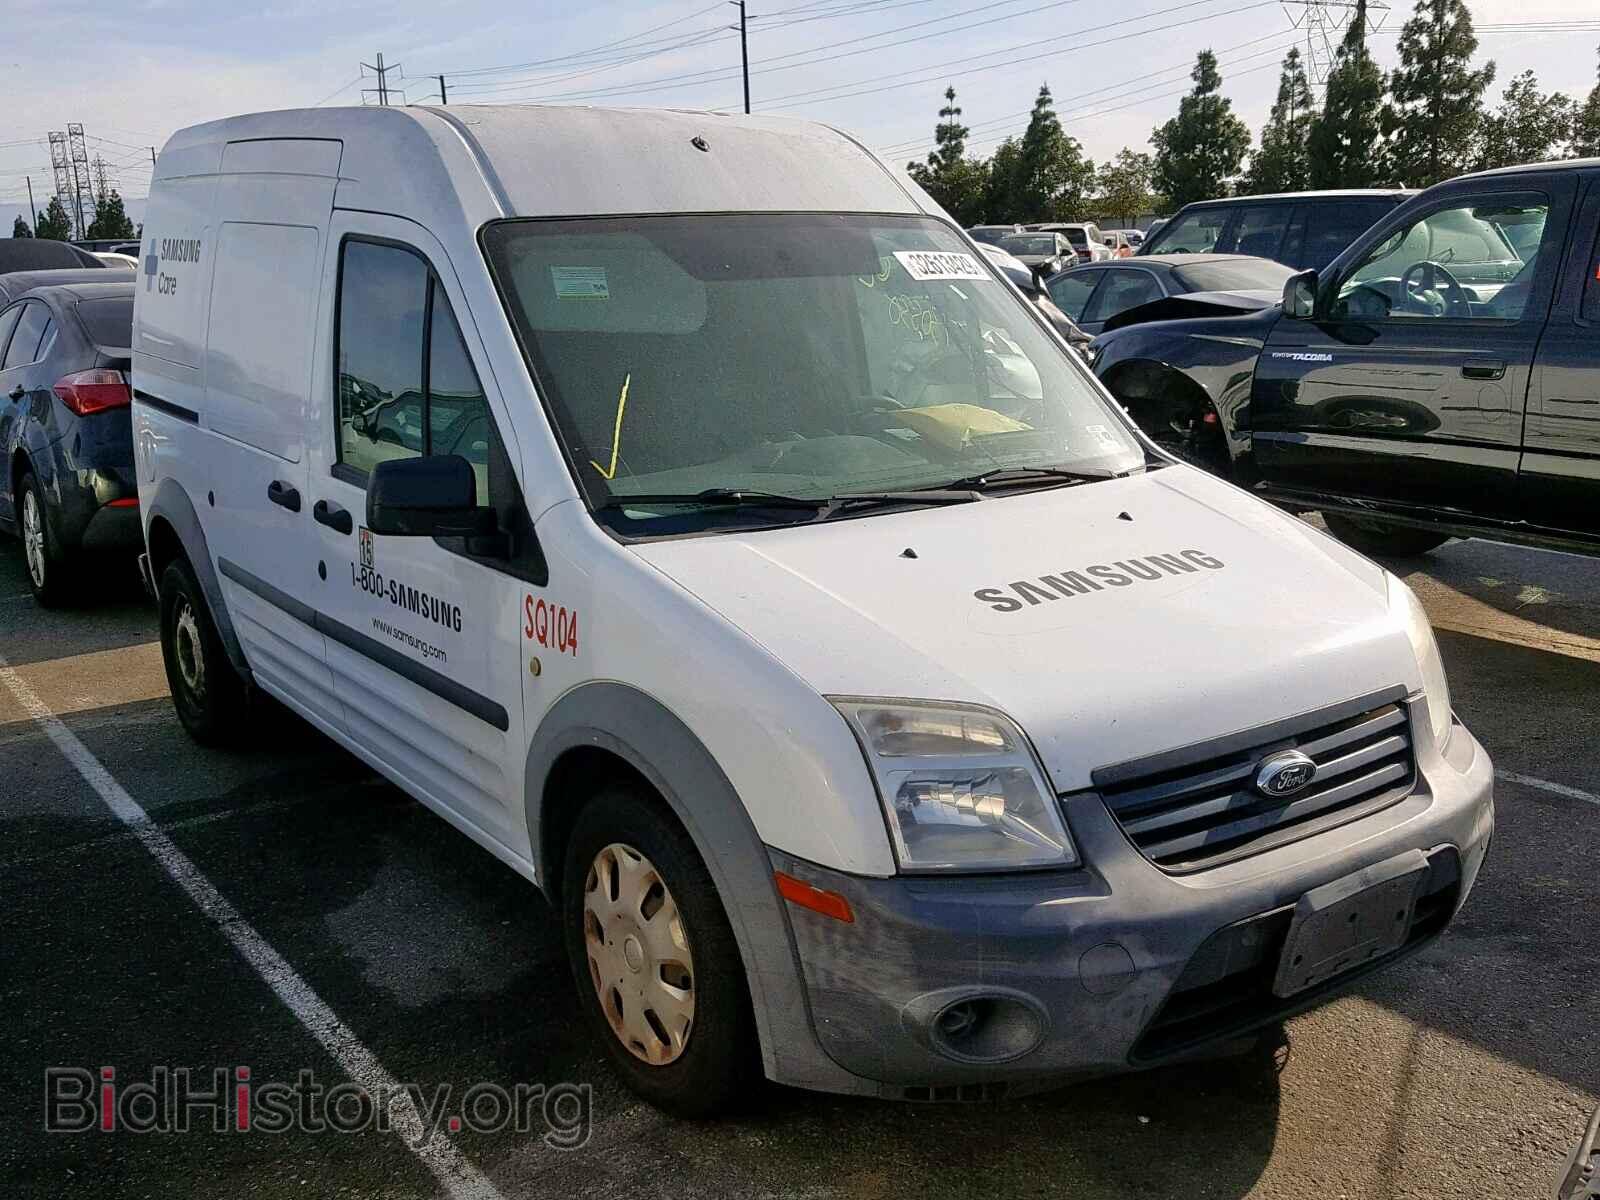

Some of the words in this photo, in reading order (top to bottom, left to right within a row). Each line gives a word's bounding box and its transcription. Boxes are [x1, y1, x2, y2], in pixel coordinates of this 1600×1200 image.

[161, 238, 201, 263] SAMSUNG
[158, 271, 177, 296] Care
[1292, 353, 1333, 361] TACOMA
[351, 561, 462, 633] 1-800-SAMSUNG
[973, 549, 1225, 612] SAMSUNG
[372, 618, 447, 662] www.samsung.com
[525, 594, 578, 657] SQ104
[1277, 767, 1308, 790] Ford
